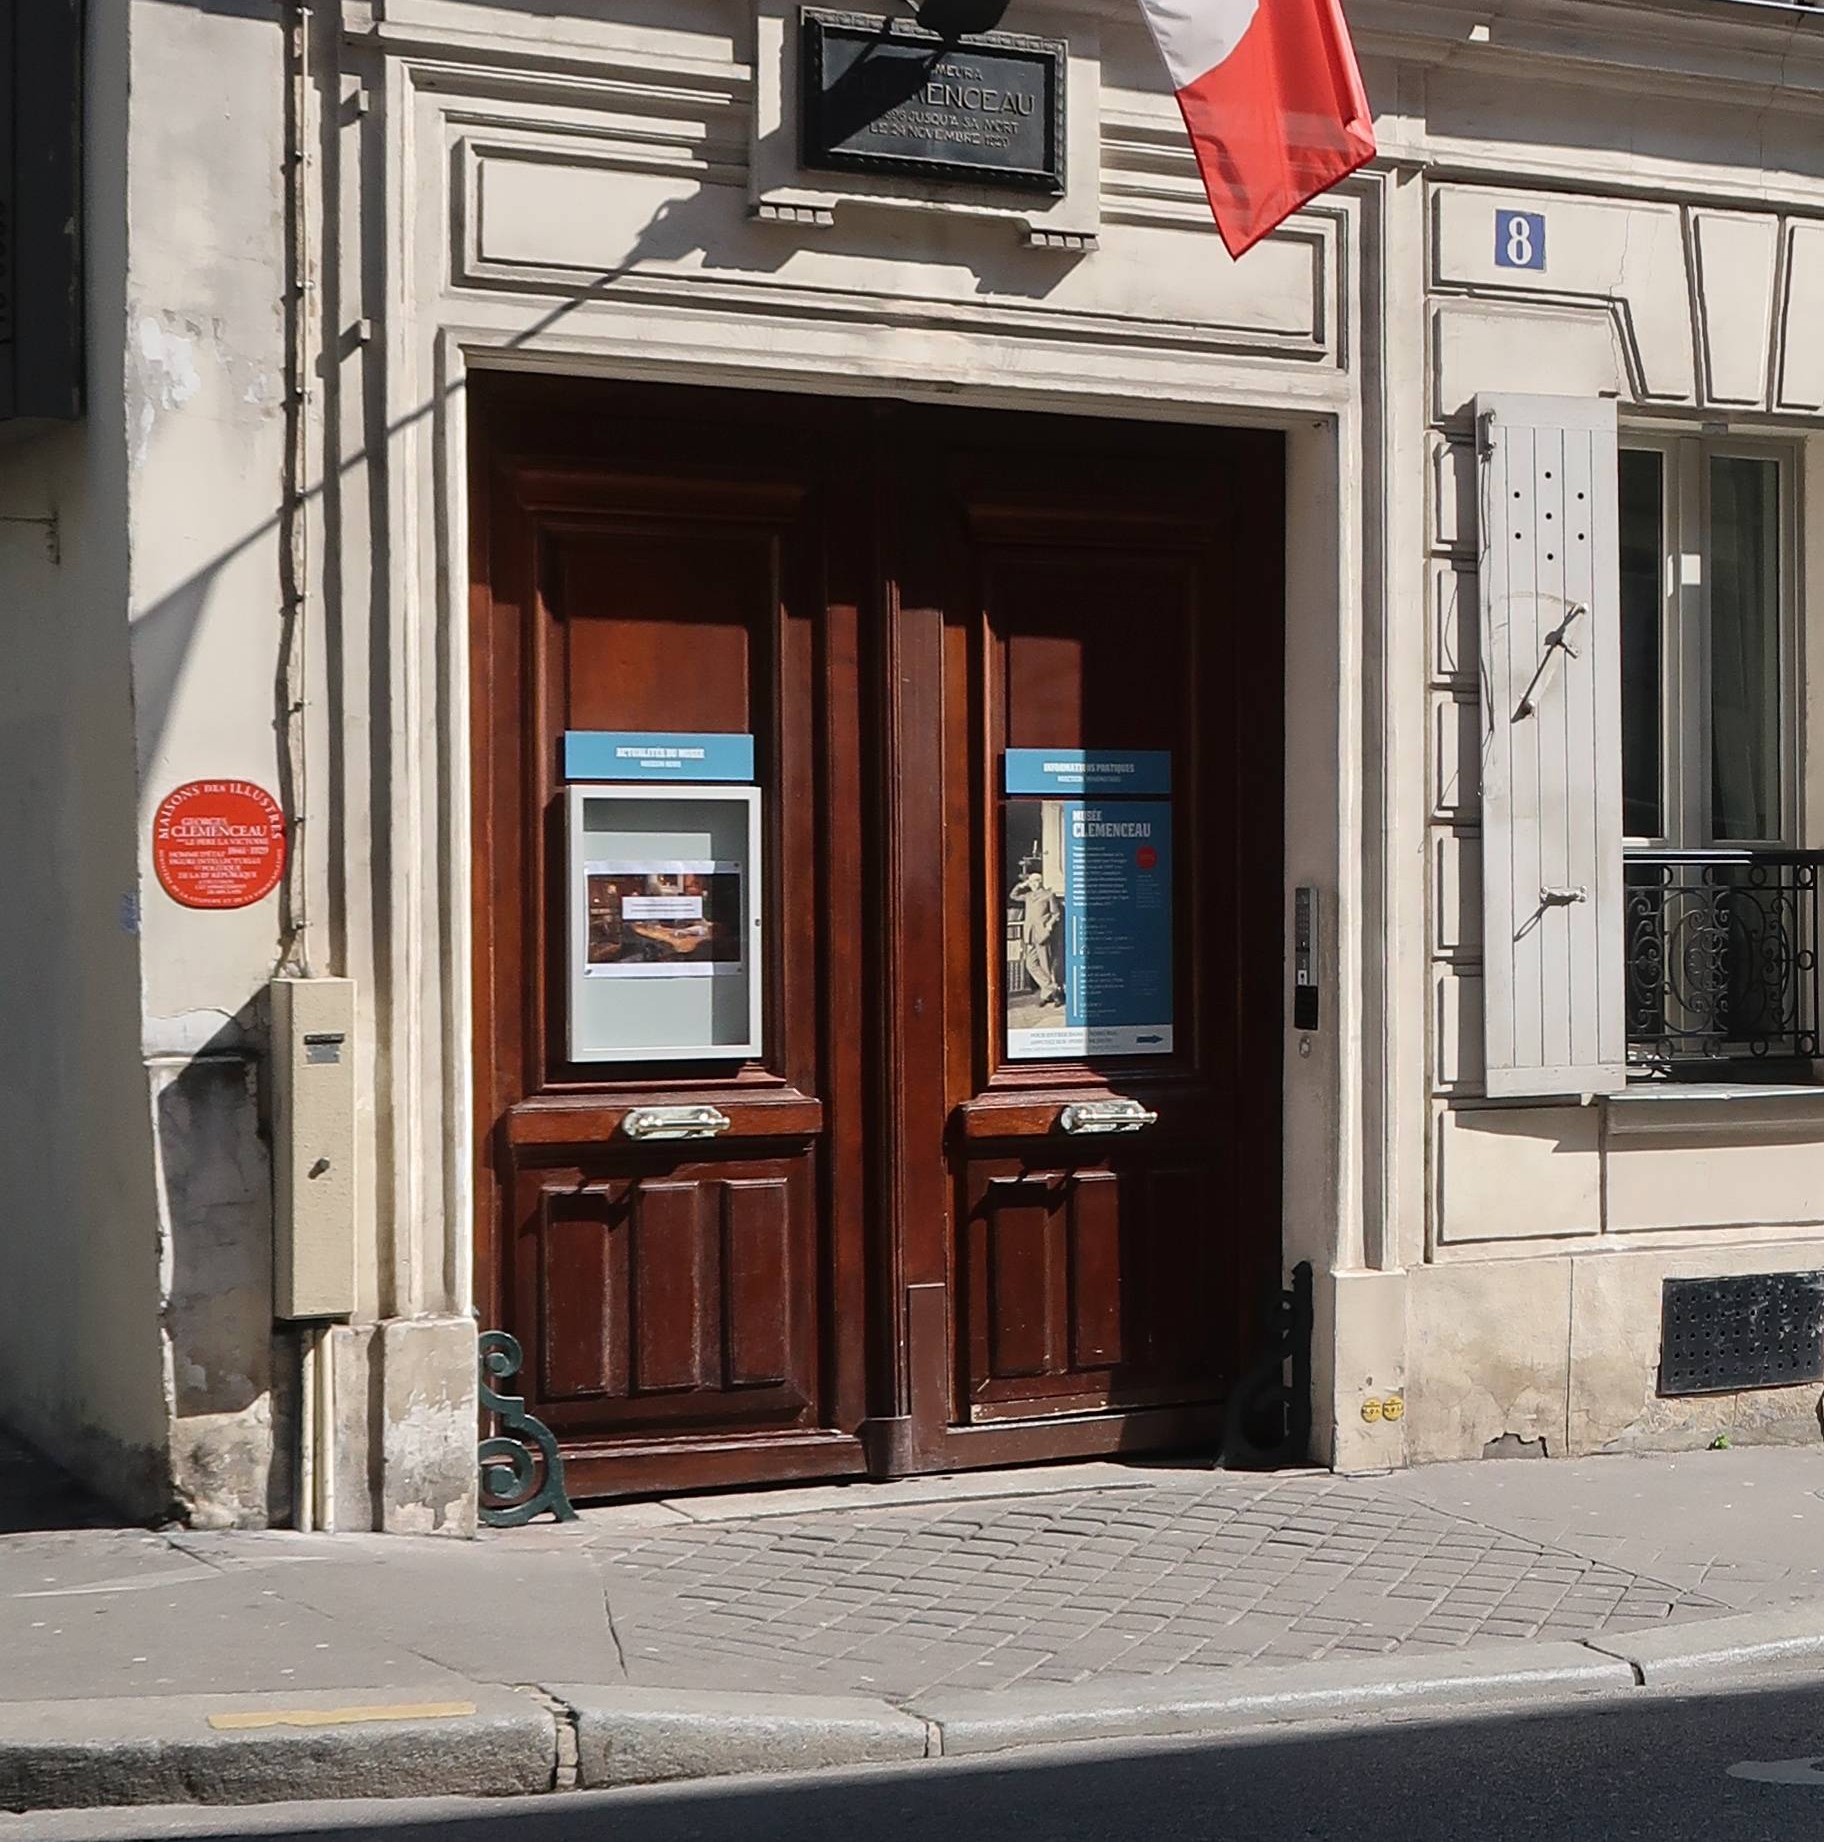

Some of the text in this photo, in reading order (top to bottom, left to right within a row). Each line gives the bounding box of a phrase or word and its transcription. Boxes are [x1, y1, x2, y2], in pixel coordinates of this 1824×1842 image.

[870, 121, 888, 135] LE
[906, 125, 981, 145] NOVEMBRE
[984, 118, 1020, 135] MORT
[1507, 216, 1533, 266] 8
[158, 784, 200, 840] MAISONS
[229, 783, 283, 840] ILLUSTRES
[171, 825, 267, 837] CLEMENCEAU
[1072, 822, 1151, 838] CLEMENCEAU
